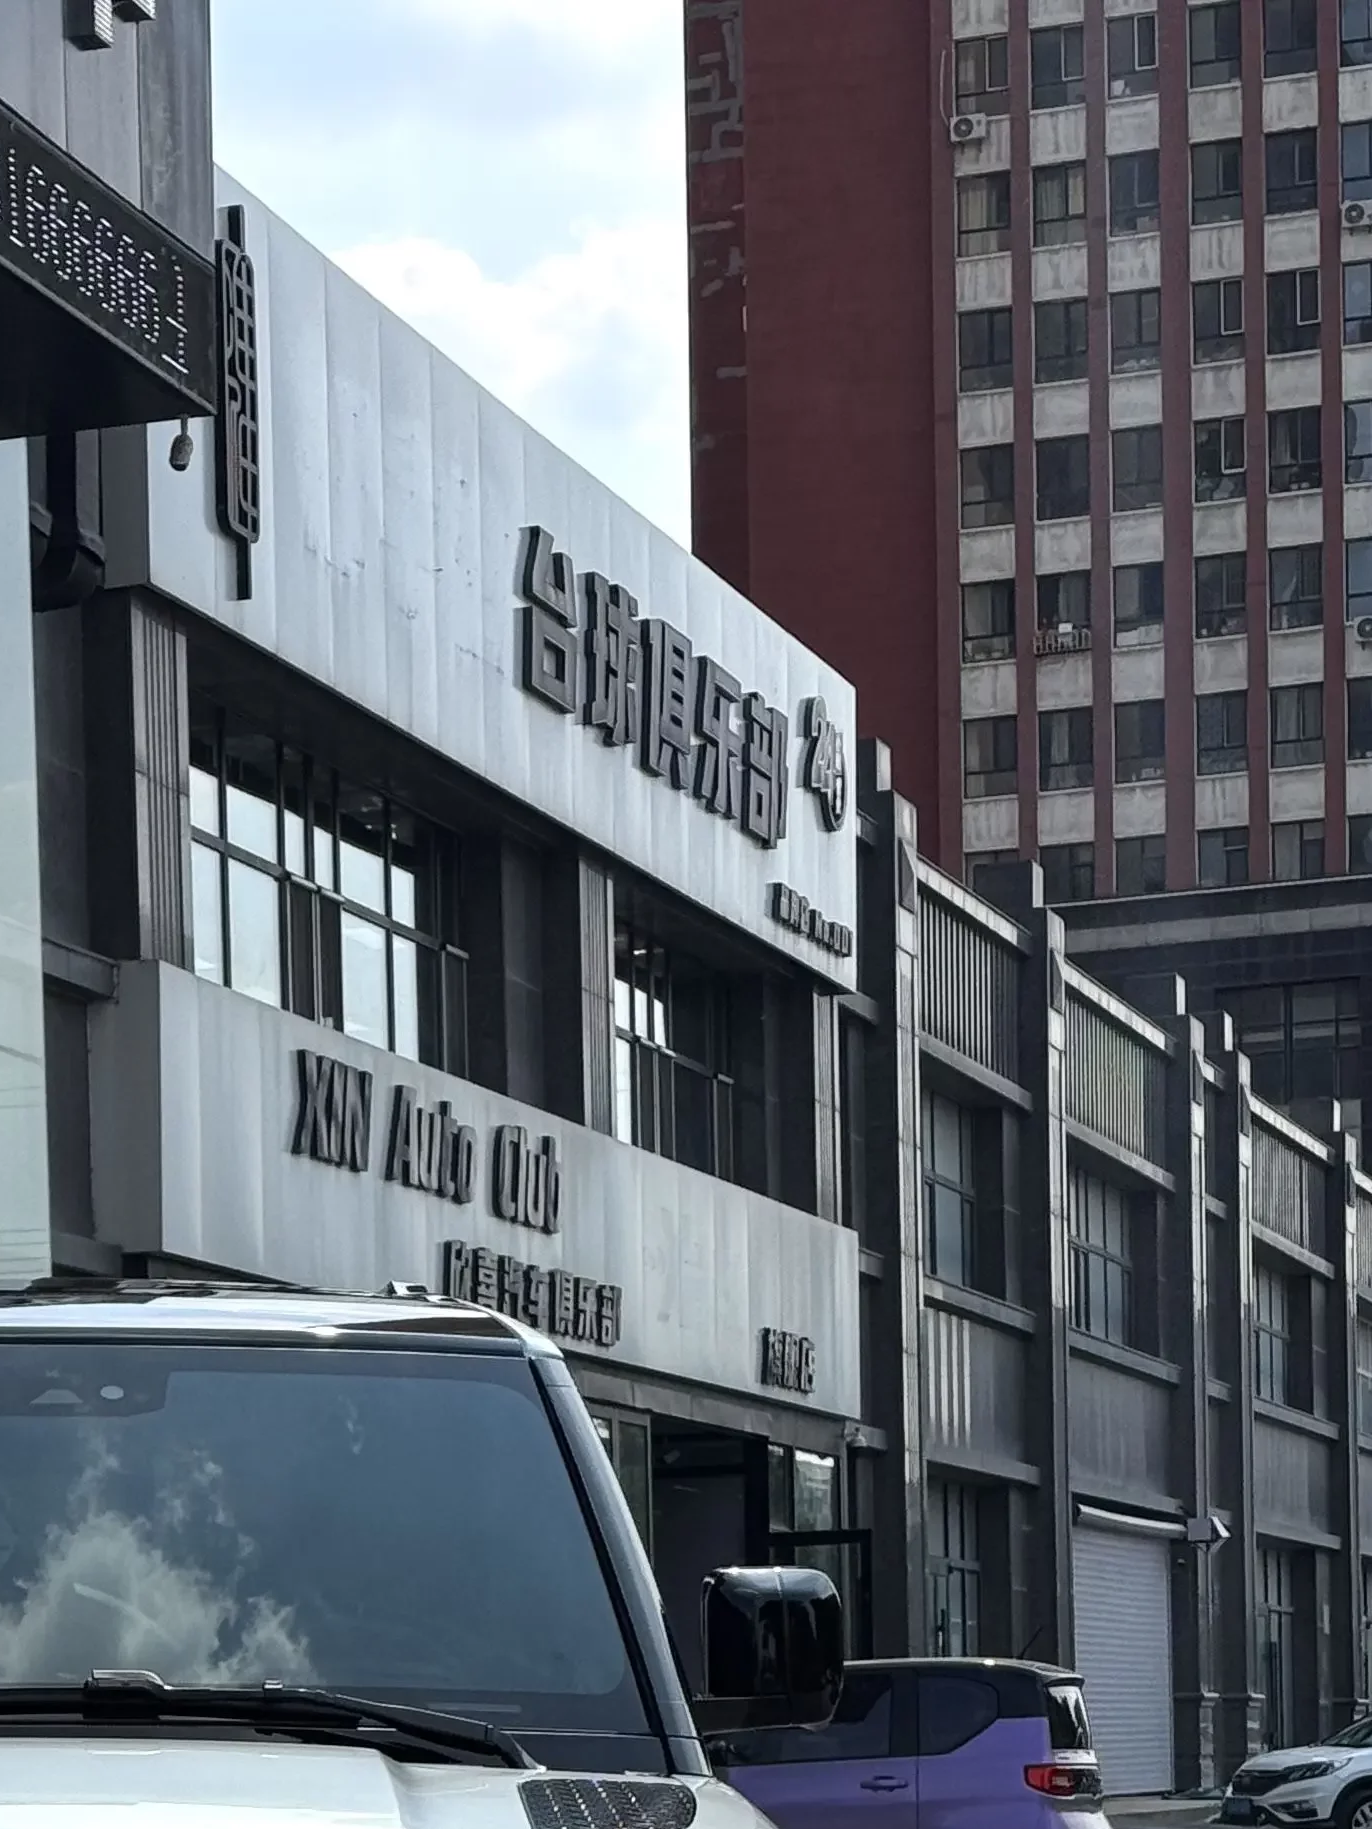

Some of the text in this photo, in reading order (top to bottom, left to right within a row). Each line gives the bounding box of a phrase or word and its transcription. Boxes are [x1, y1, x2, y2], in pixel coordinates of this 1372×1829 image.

[520, 525, 789, 849] 台球俱乐部
[292, 1049, 560, 1235] XIN Auto Club
